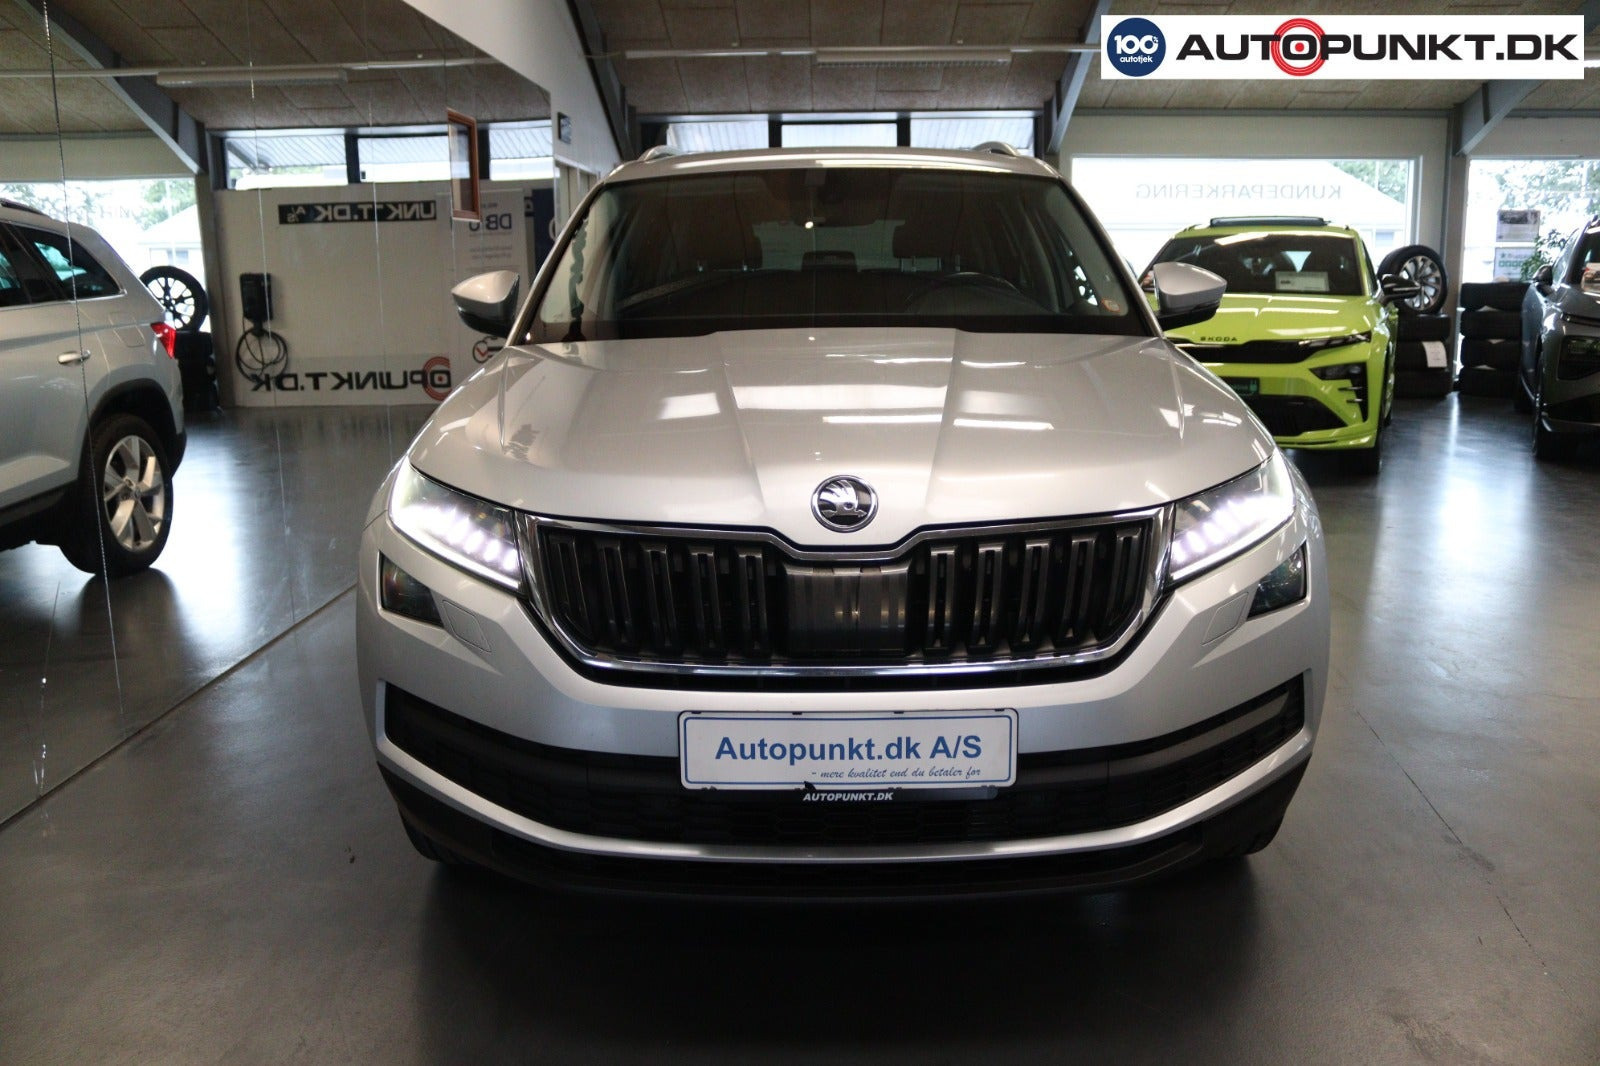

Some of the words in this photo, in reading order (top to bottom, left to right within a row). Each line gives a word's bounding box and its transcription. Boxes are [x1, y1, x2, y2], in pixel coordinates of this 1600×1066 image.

[715, 736, 921, 766] Autopunkt.dk
[929, 735, 982, 759] A/S
[847, 768, 887, 778] kvalitet
[890, 767, 907, 777] end
[911, 766, 925, 777] du
[928, 766, 963, 777] betaler
[965, 766, 981, 779] for
[803, 792, 894, 801] AUTOPUNKT.DK
